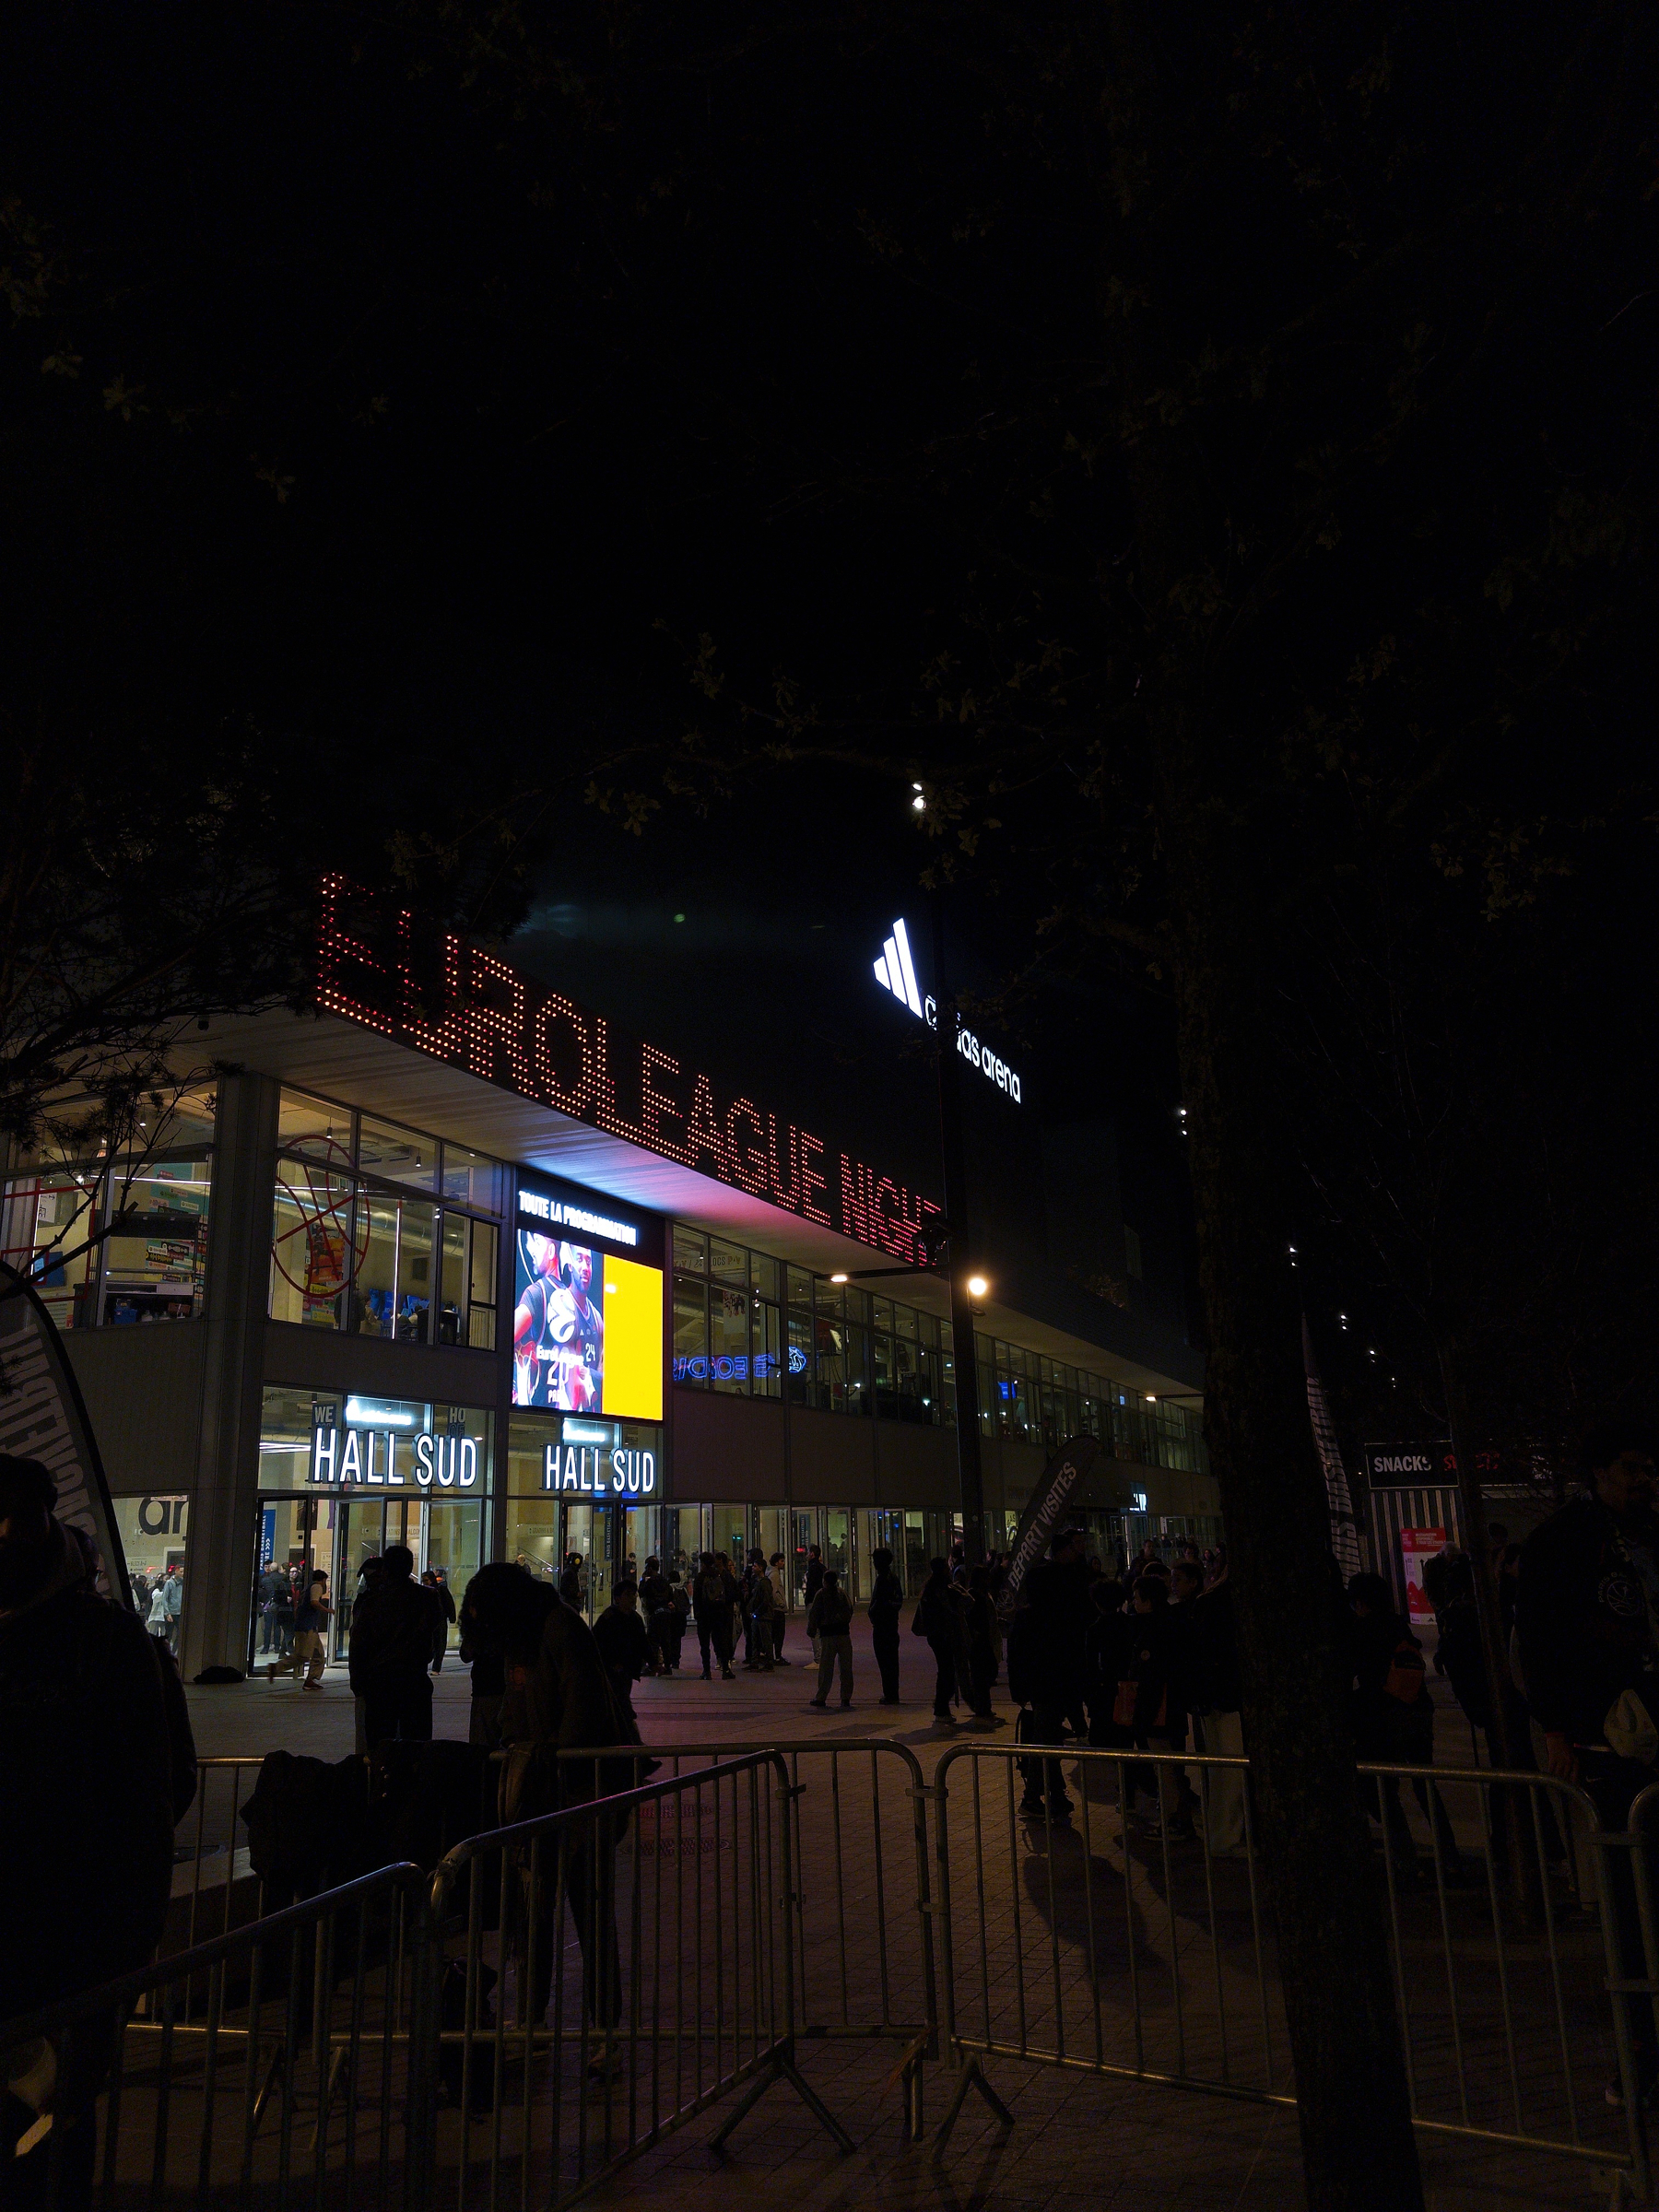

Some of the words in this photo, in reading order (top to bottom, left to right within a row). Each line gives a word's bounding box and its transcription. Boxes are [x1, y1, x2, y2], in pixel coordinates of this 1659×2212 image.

[318, 872, 830, 1226] EUROLEAGUE
[982, 1045, 1021, 1104] arena
[519, 1190, 549, 1219] TOUTE
[550, 1201, 562, 1223] LA
[585, 1342, 596, 1362] 24
[314, 1406, 334, 1423] WE
[313, 1427, 404, 1484] HALL
[415, 1434, 477, 1487] SUD
[546, 1444, 606, 1490] HALL
[612, 1449, 655, 1493] SUD
[1374, 1455, 1431, 1473] SNACKS
[1007, 1520, 1045, 1592] DEPART
[1037, 1461, 1077, 1526] VISITES
